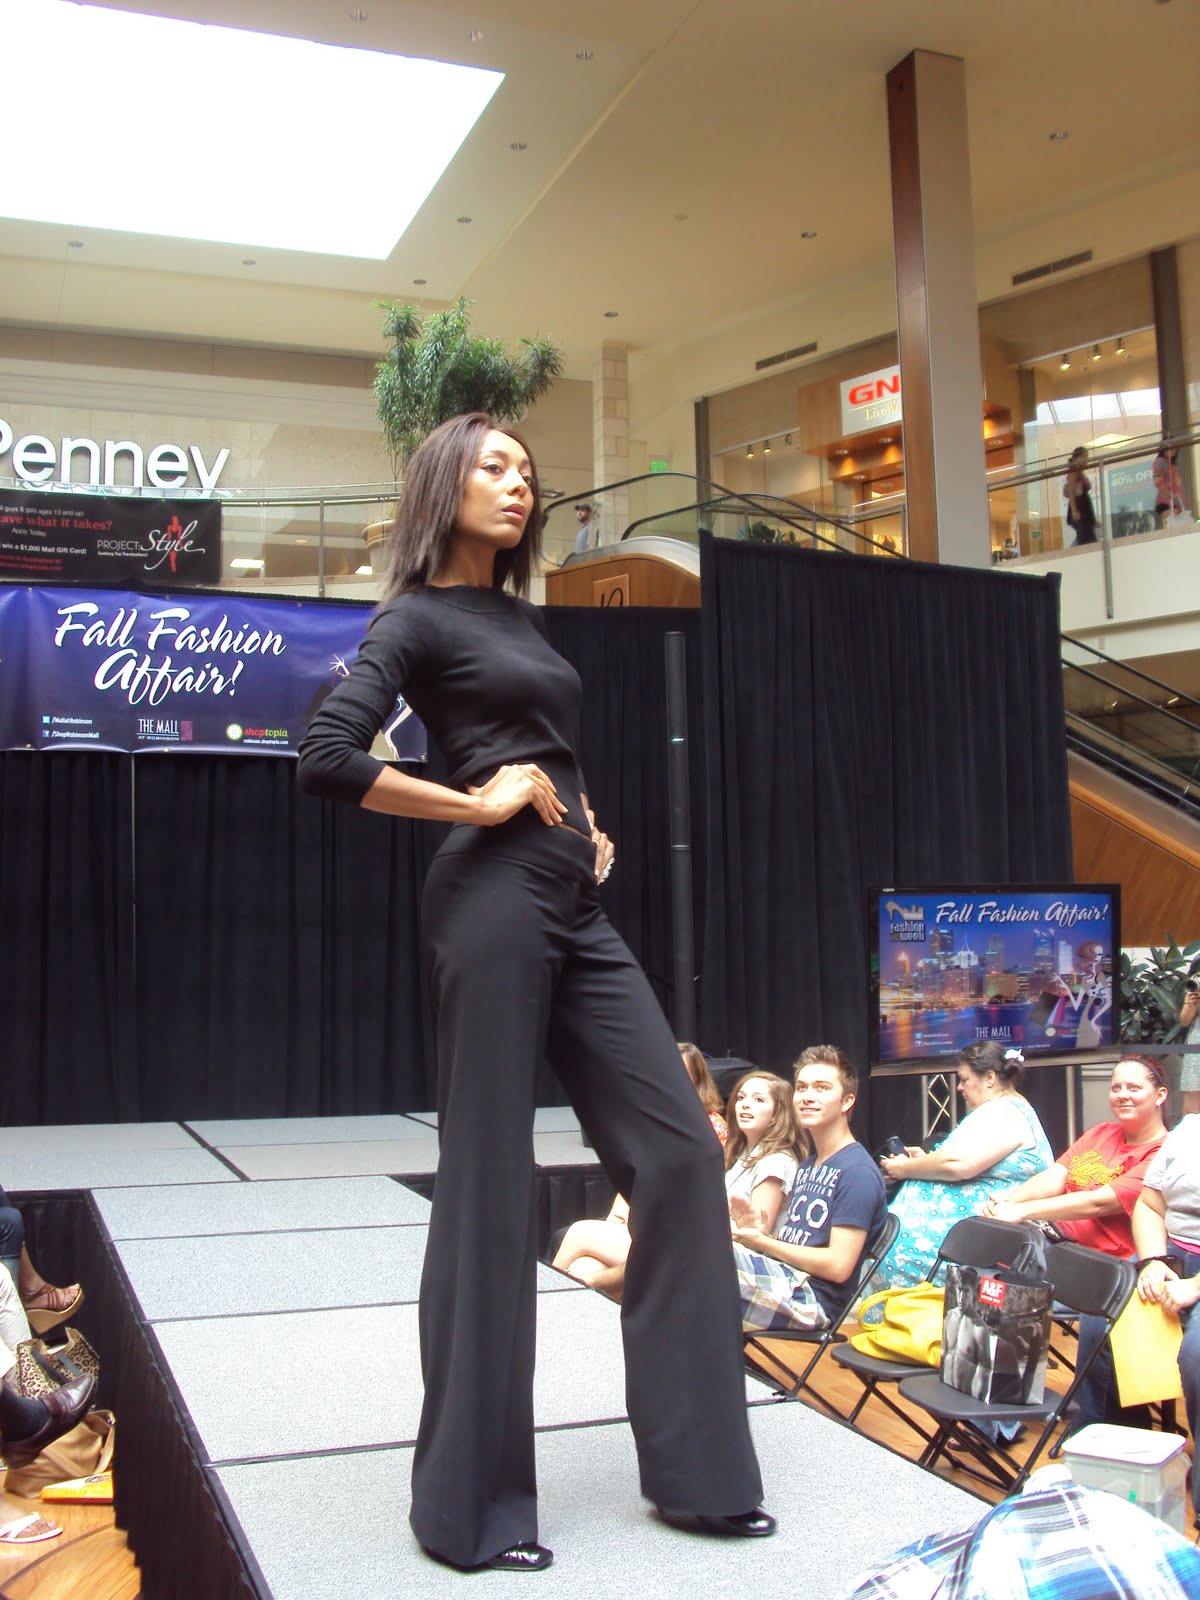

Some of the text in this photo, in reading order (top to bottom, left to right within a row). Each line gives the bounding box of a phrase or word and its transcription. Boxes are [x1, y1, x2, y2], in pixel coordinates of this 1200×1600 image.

[848, 373, 900, 406] GN
[865, 401, 899, 420] LiveW
[0, 514, 113, 531] ave what it takes?
[12, 527, 28, 536] Apply
[20, 543, 41, 552] $1,000
[69, 547, 87, 555] Card!
[97, 519, 206, 571] PROJECT: Style
[54, 602, 287, 656] Fall Fashion
[94, 647, 244, 706] Affair!
[137, 718, 179, 735] THE MALL
[243, 727, 289, 739] shoptopia
[936, 901, 1109, 928] Fall Fashion Affair!
[890, 921, 925, 934] fashion
[900, 930, 925, 941] week
[975, 1025, 1012, 1039] THE MALL
[982, 1279, 1004, 1298] A&F
